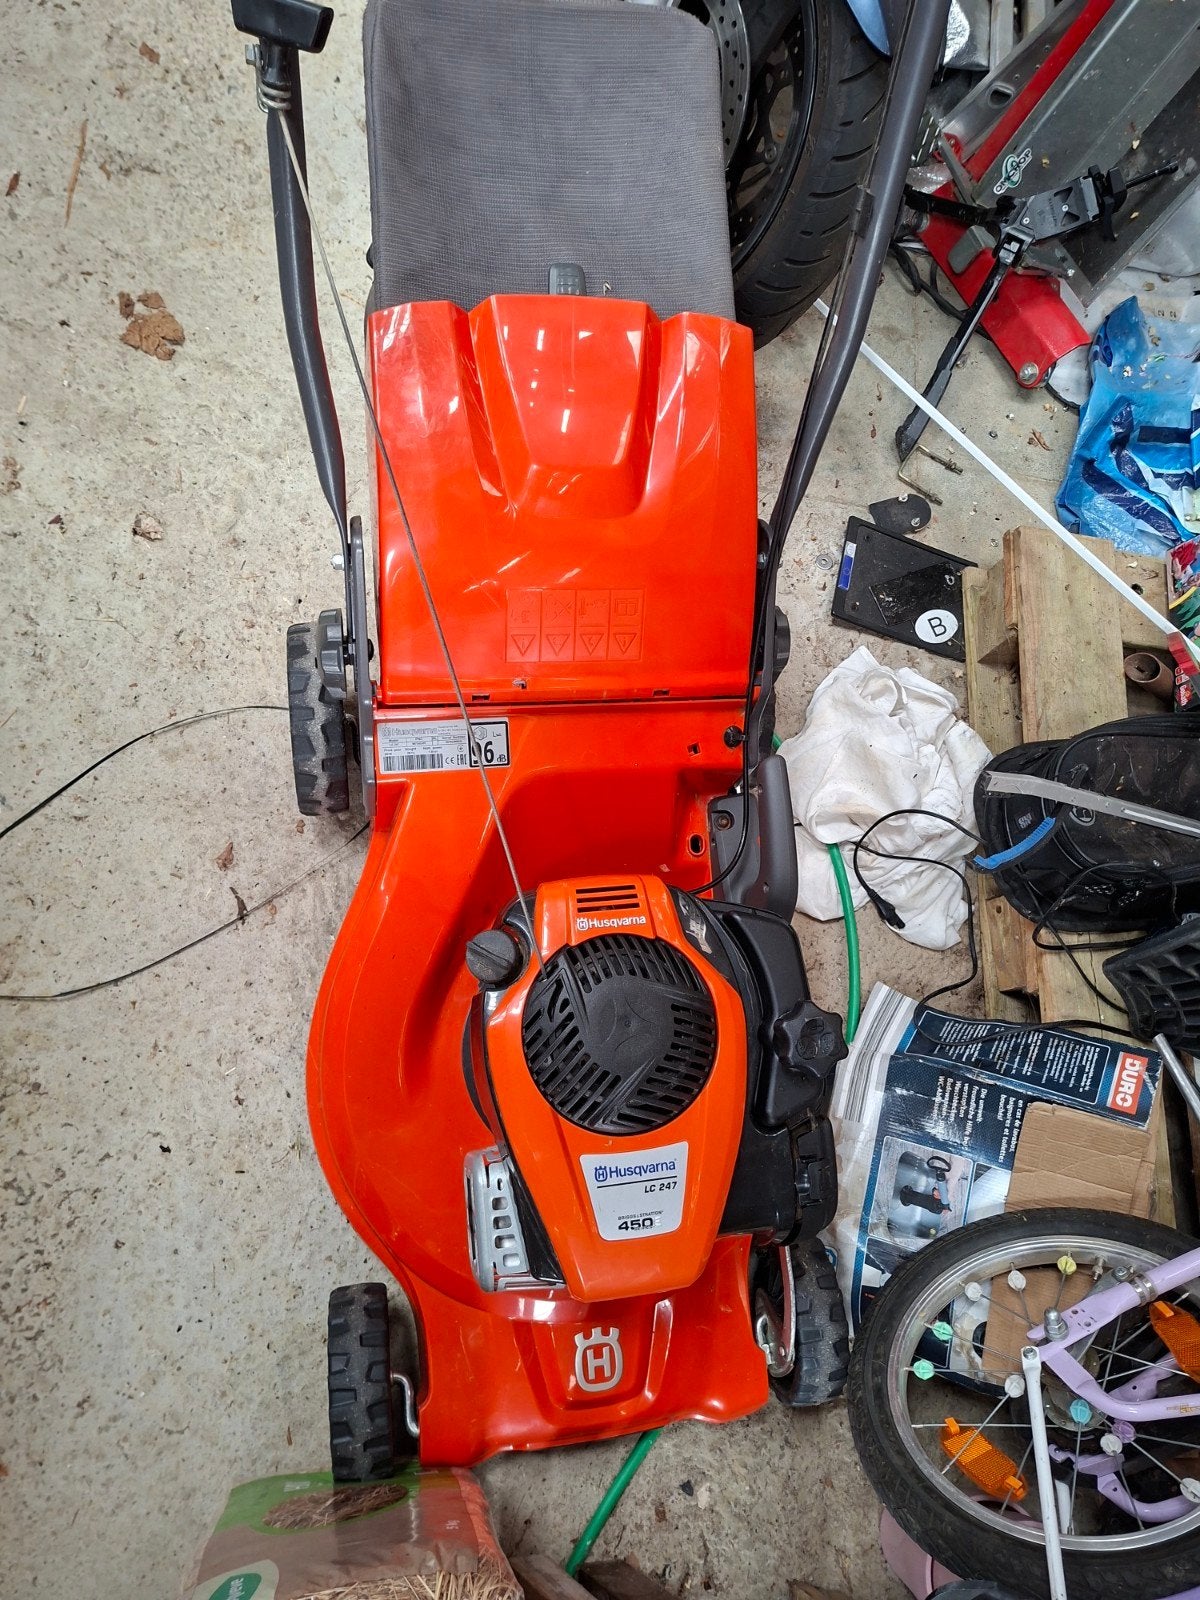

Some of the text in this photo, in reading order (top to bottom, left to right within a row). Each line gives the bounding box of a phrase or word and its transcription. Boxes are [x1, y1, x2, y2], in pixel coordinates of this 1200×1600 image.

[927, 616, 948, 638] B
[589, 915, 647, 928] Husqvarna
[1114, 1057, 1141, 1107] DURO
[609, 1160, 676, 1179] Husqvarna
[644, 1181, 678, 1194] LC 247
